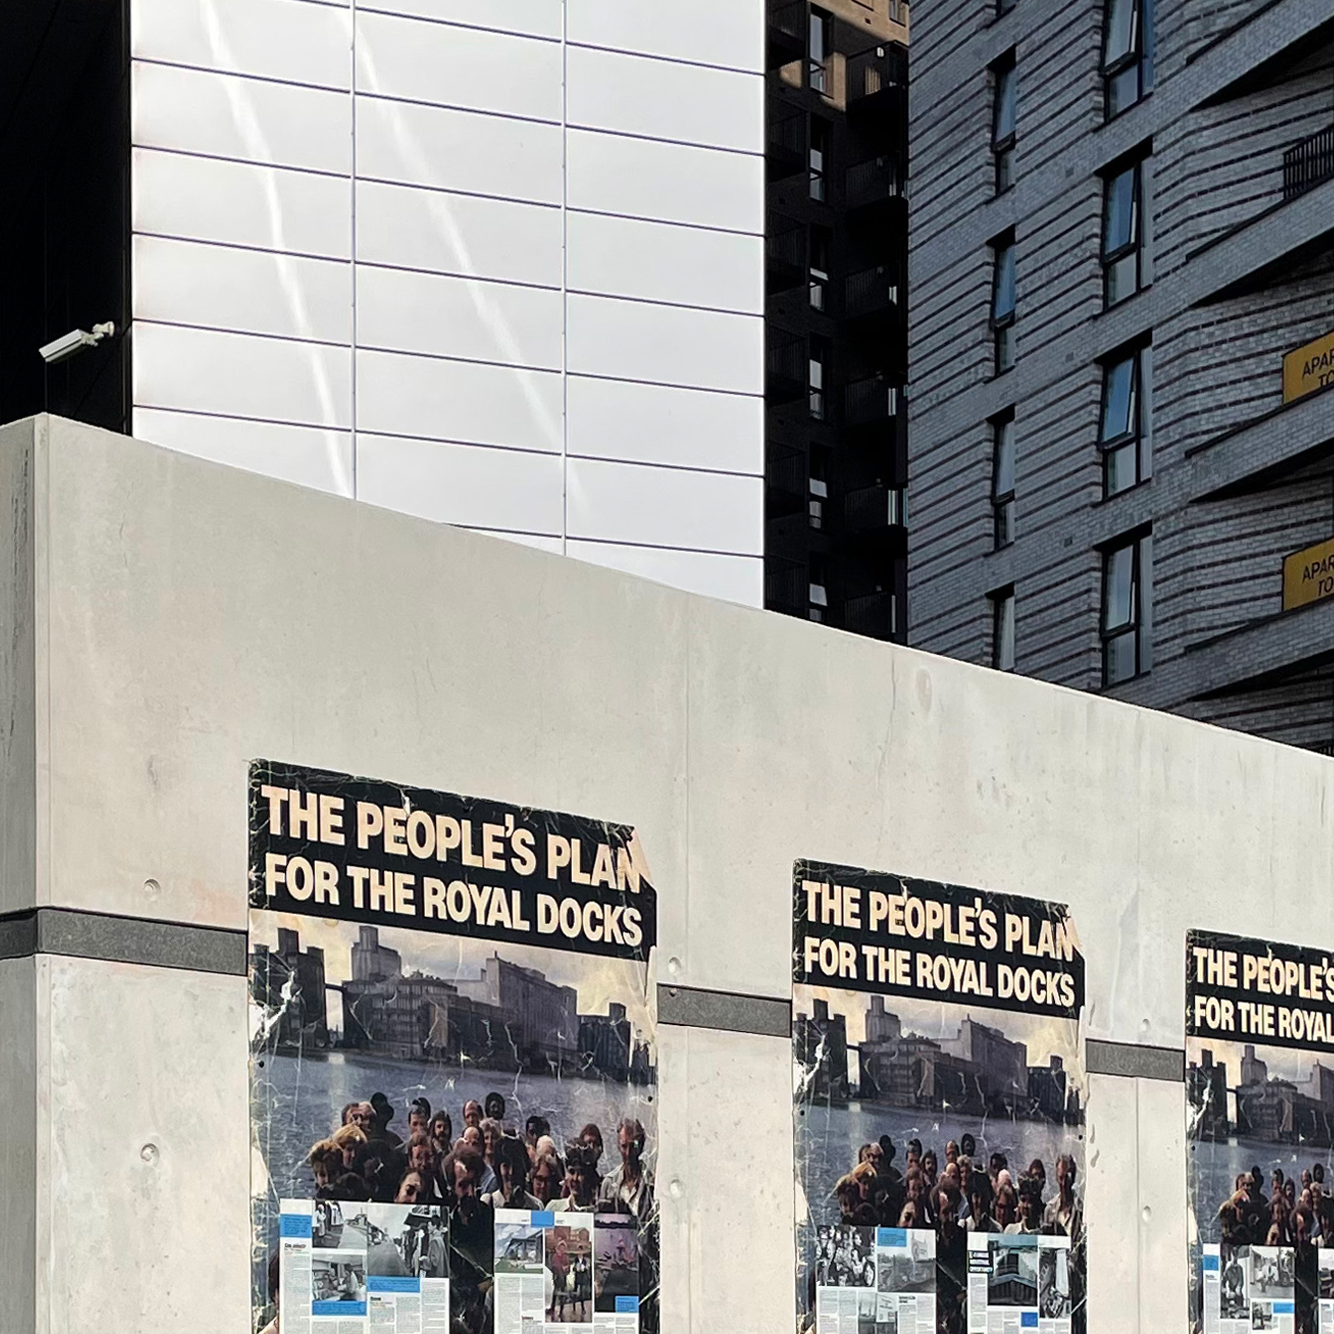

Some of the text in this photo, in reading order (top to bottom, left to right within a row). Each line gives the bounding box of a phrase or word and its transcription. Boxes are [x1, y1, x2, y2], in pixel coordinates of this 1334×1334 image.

[1318, 576, 1334, 597] TO
[261, 784, 641, 894] THE PEOPLE'S PLAN
[265, 852, 643, 948] FOR THE ROYAL DOCKS
[802, 879, 1074, 962] THE PEOPLE'S PLAN
[804, 935, 1075, 1007] FOR THE ROYAL DOCKS
[1193, 946, 1238, 988] THE
[1194, 995, 1235, 1032] FOR
[1237, 1001, 1275, 1036] THE
